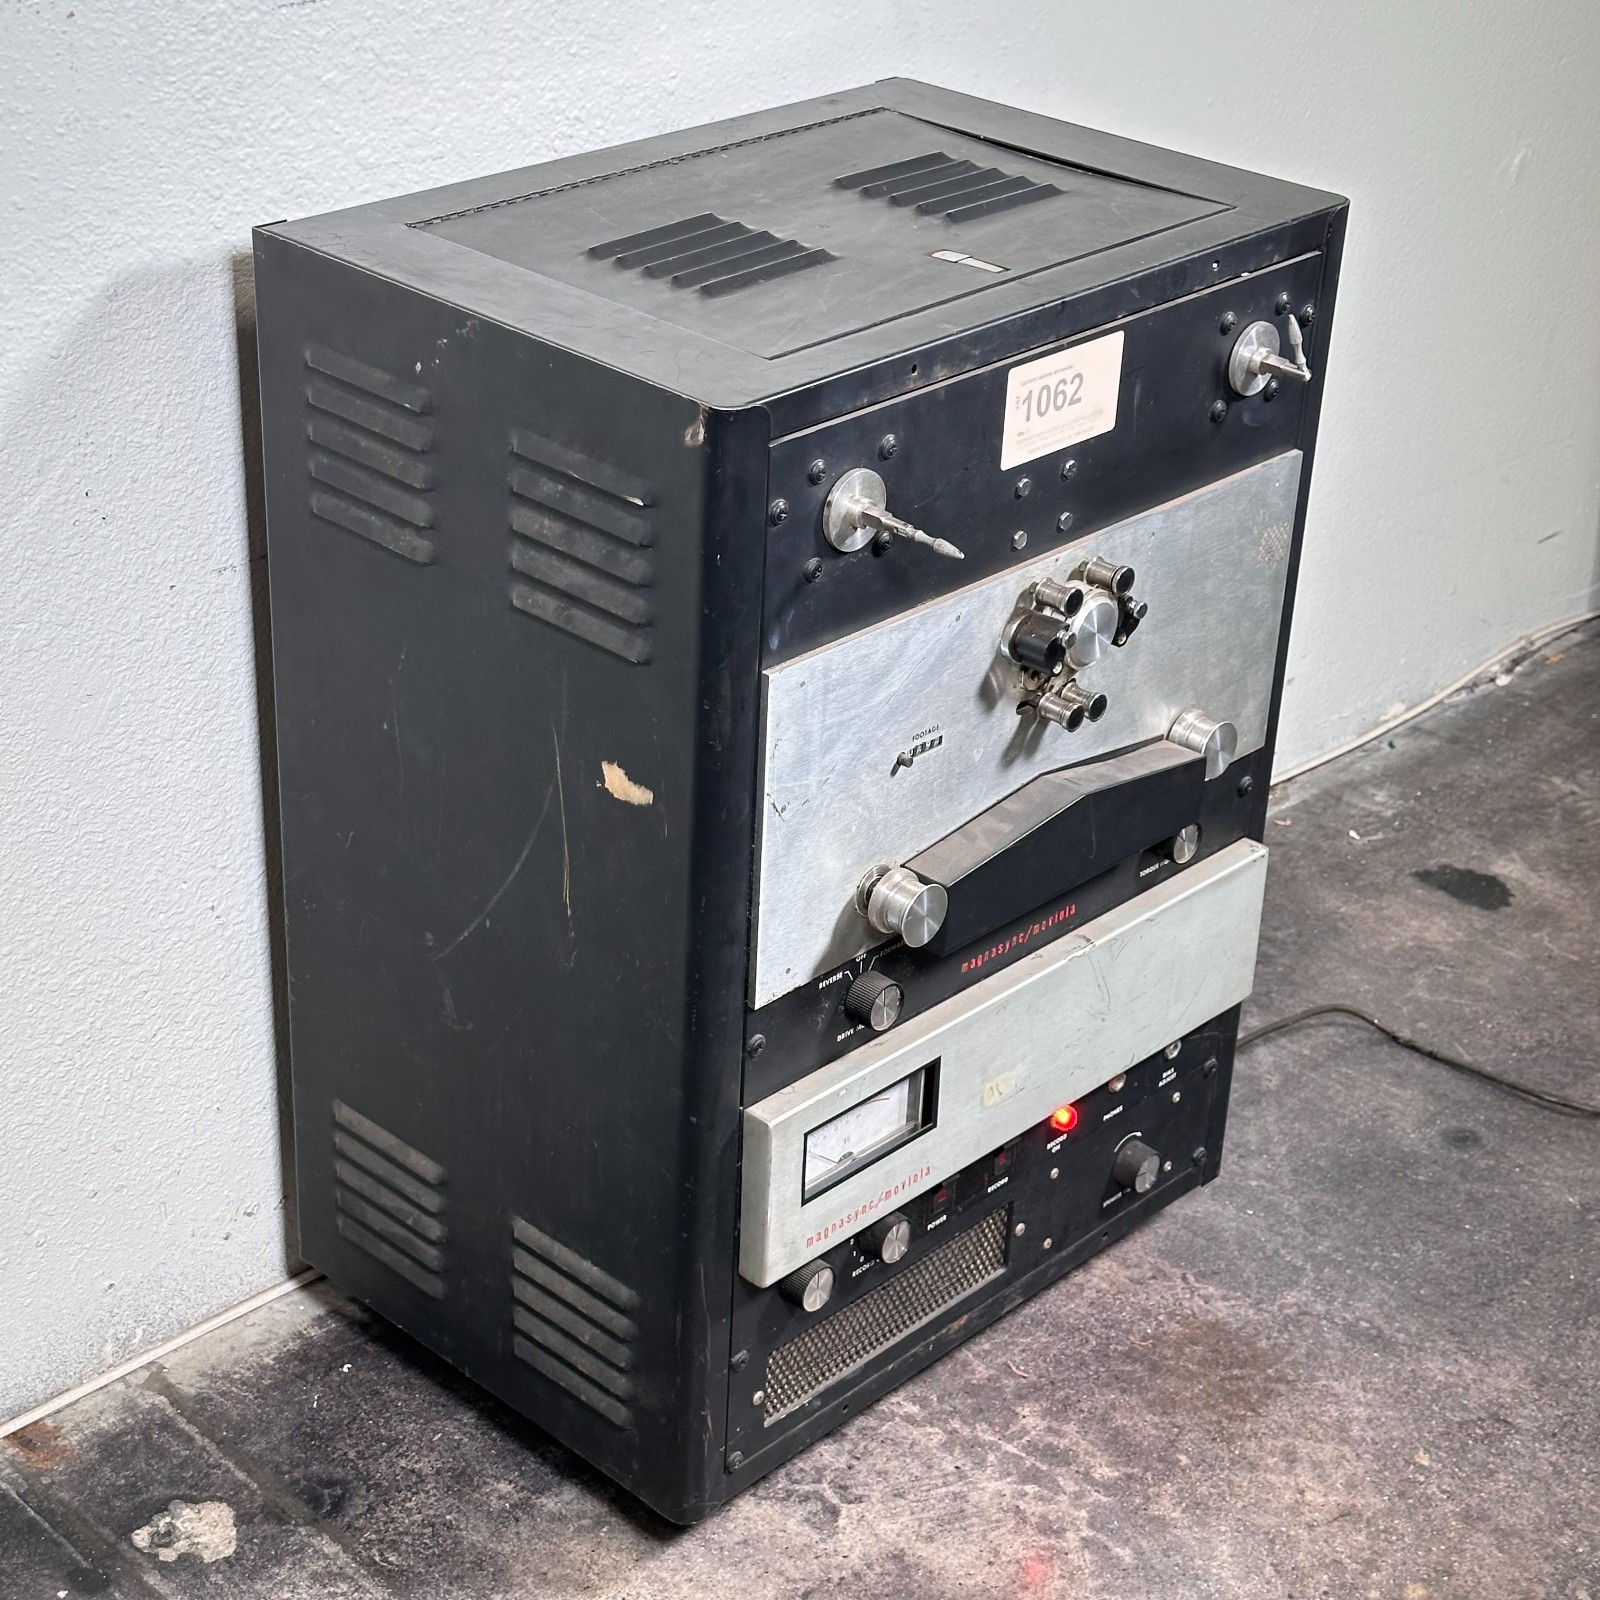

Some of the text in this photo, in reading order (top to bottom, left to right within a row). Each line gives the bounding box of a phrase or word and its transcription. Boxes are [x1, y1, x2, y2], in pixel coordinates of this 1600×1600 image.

[1022, 372, 1084, 423] 1062
[911, 723, 940, 742] FOOTAGE
[960, 903, 1077, 974] magnasync/moviola
[855, 953, 867, 962] OFF
[879, 940, 907, 957] FORWAR
[818, 971, 843, 990] REVERSE
[836, 1028, 854, 1042] DRIVE
[1046, 1132, 1068, 1150] RECORD
[986, 1176, 1009, 1193] RECORD
[805, 1165, 932, 1248] magnasync/moviola
[926, 1214, 948, 1231] POWER
